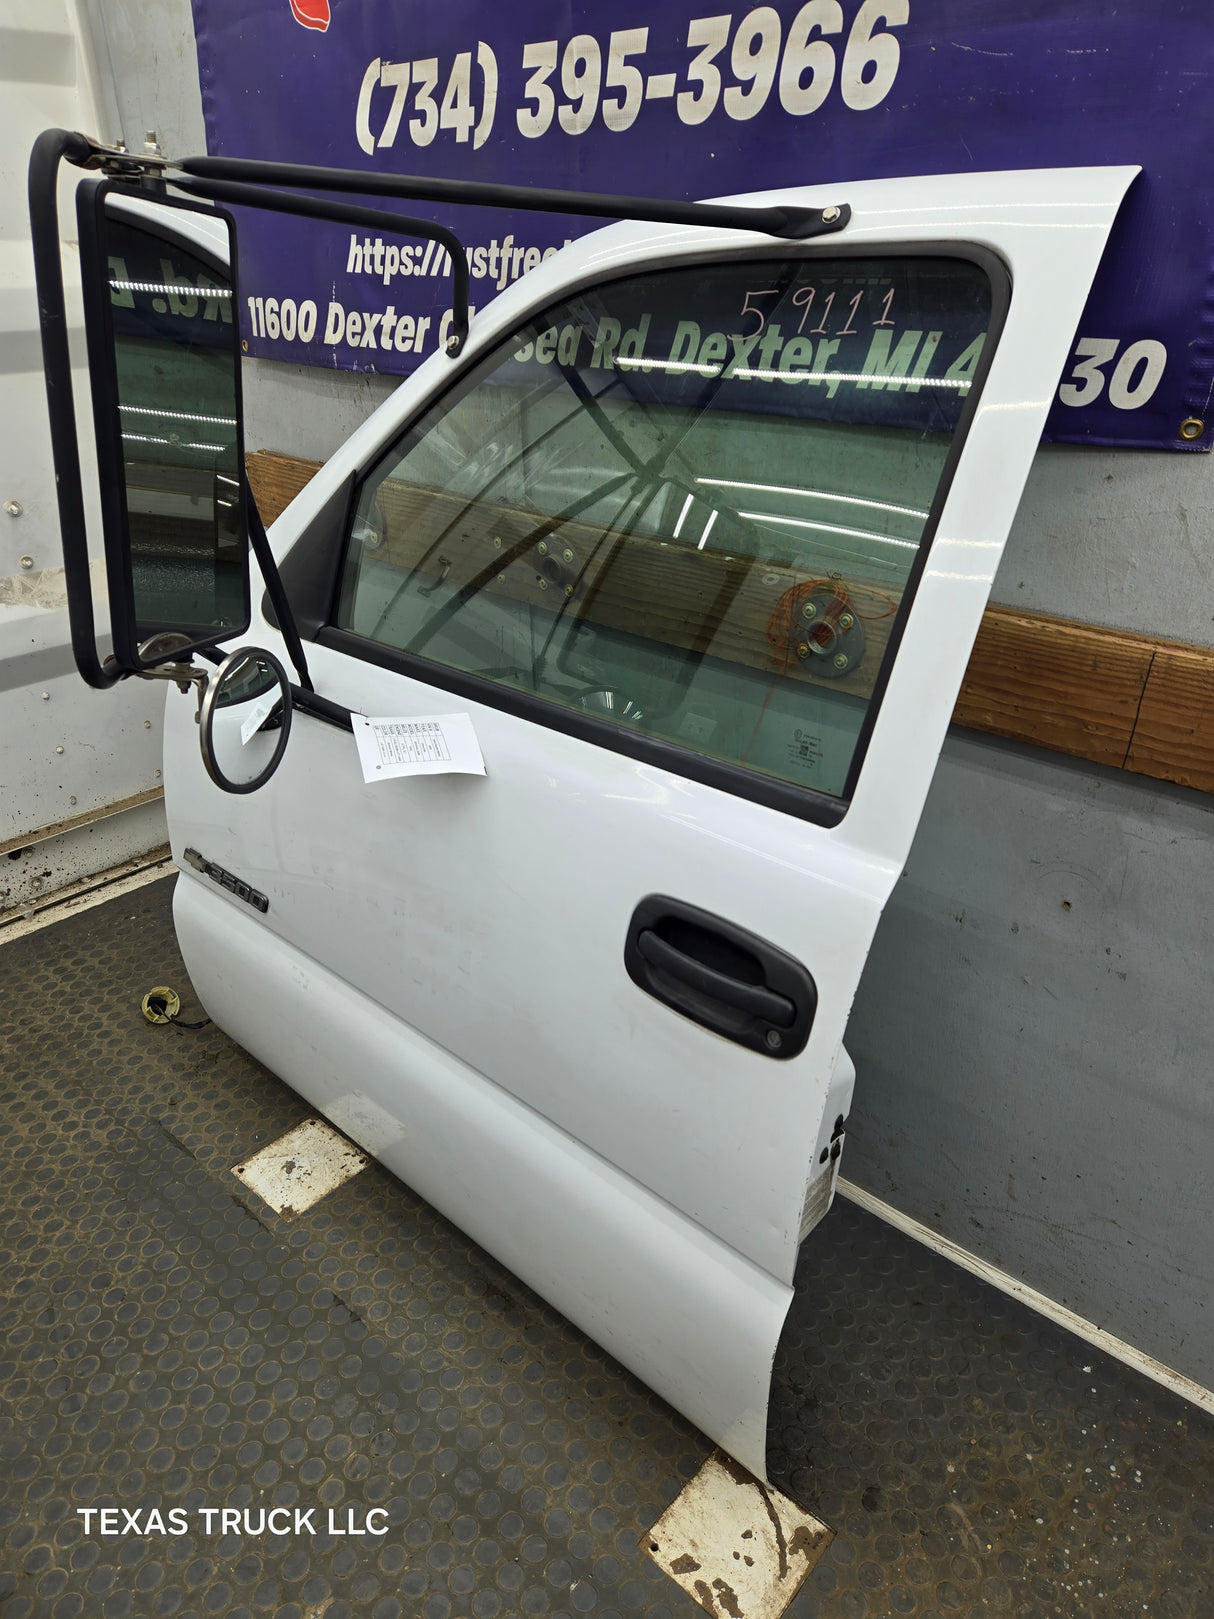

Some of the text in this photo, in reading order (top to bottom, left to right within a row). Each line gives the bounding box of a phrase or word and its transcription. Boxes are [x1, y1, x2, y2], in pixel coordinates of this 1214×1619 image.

[355, 0, 910, 156] (734) 395-3966
[248, 296, 318, 343] 11600
[323, 301, 431, 353] Dexter
[665, 320, 841, 399] Dexter,
[855, 328, 944, 393] MI
[727, 287, 896, 341] 59111
